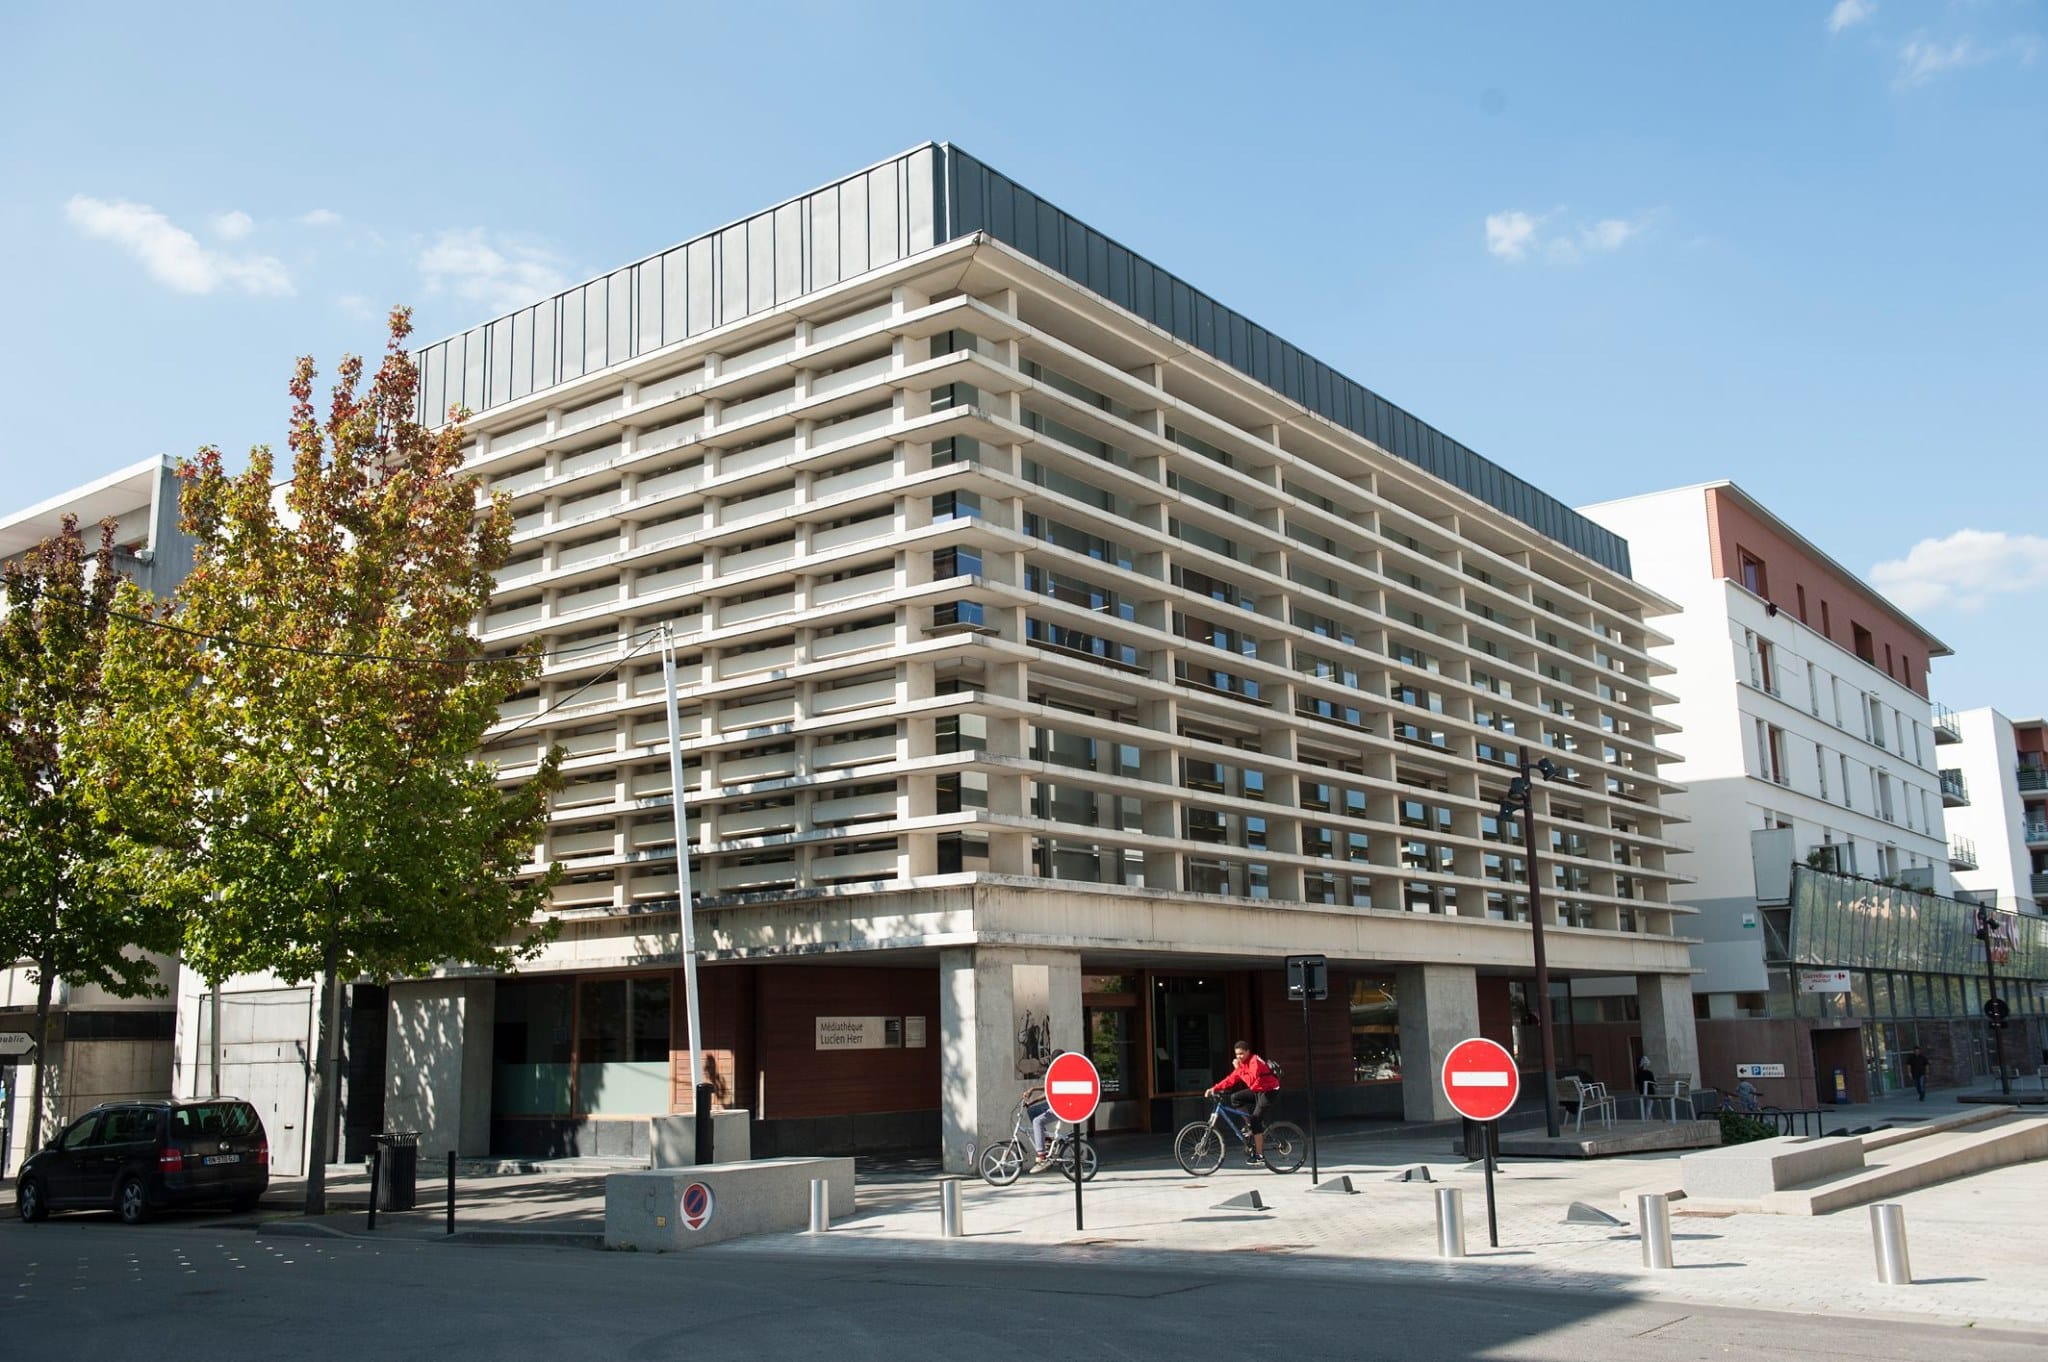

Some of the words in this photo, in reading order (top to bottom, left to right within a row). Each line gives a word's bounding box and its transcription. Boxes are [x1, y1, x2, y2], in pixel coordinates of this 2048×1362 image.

[820, 1021, 863, 1033] Médiathèque
[820, 1034, 845, 1045] Lucien
[847, 1033, 863, 1044] Herr
